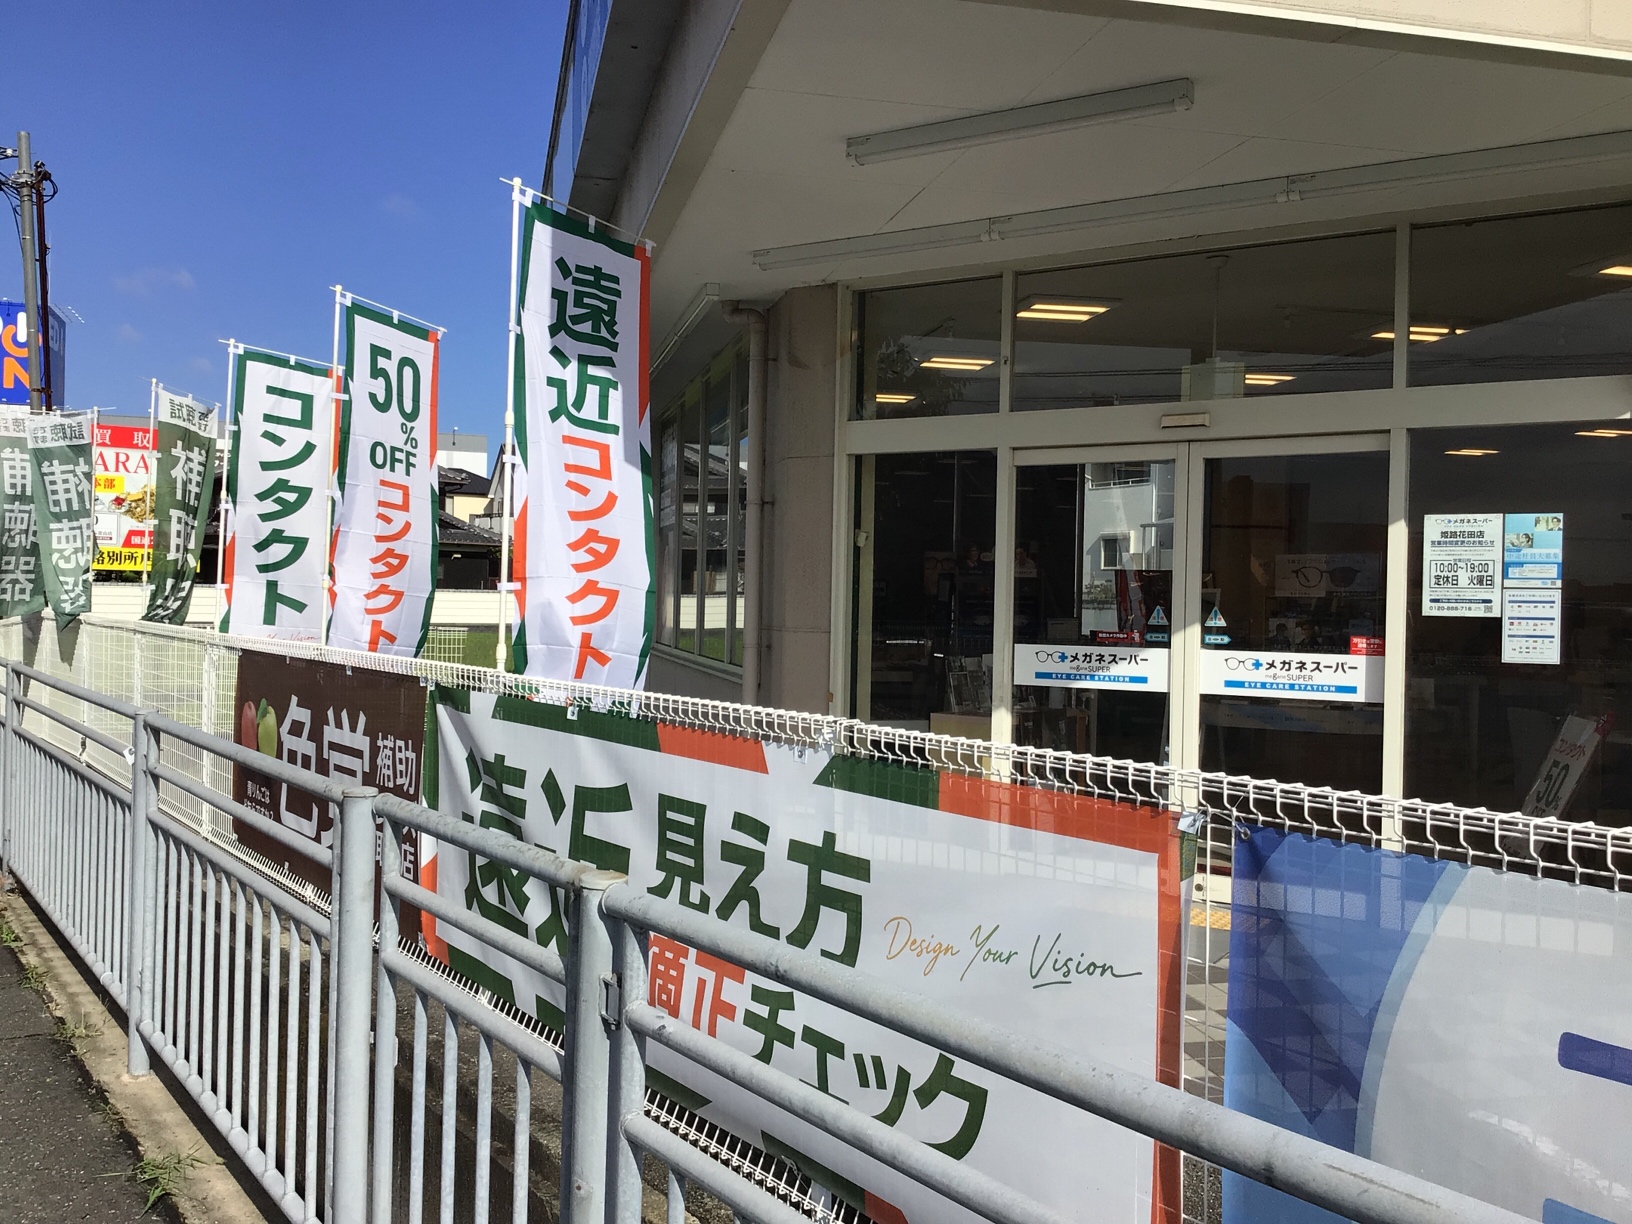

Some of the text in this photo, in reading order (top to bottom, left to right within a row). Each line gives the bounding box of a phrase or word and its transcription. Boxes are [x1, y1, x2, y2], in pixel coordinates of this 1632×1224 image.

[368, 342, 421, 424] 50
[369, 441, 417, 477] OFF
[252, 384, 317, 626] コンタクト
[1440, 530, 1485, 539] 姫路花田店
[363, 479, 412, 653] コンタクト
[1433, 575, 1493, 586] 定休日 火曜日
[1069, 652, 1149, 666] メガネスーパー
[1265, 659, 1359, 674] メガネスーパー
[1294, 684, 1336, 692] STATION
[375, 731, 417, 795] 補助
[1535, 759, 1570, 808] 50
[646, 792, 872, 969] 見え方
[884, 916, 1143, 981] Design Your Vision
